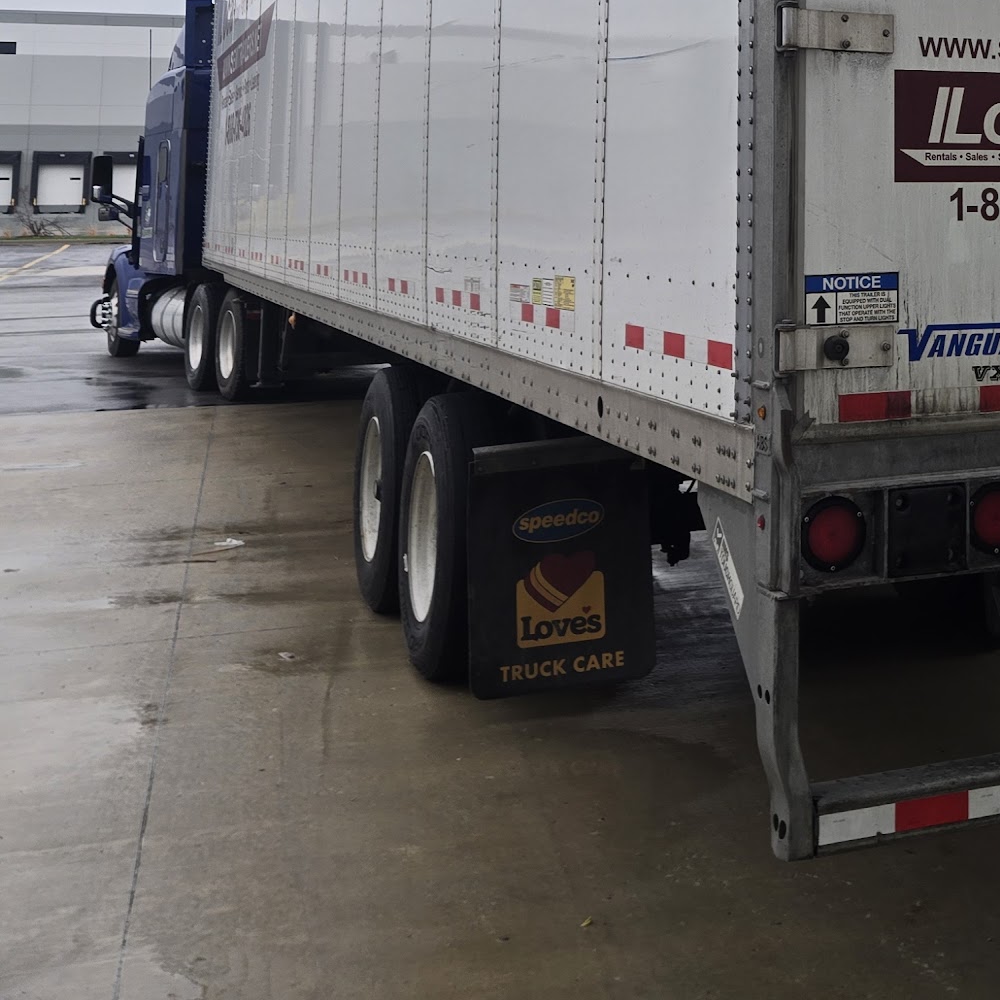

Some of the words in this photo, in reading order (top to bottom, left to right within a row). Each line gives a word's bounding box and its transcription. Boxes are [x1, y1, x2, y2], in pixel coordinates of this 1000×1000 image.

[925, 152, 957, 162] Rentals
[965, 152, 988, 162] Sales
[823, 276, 881, 290] NOTICE
[519, 508, 599, 533] speedco
[500, 659, 566, 682] TRUCK
[573, 651, 625, 672] CARE
